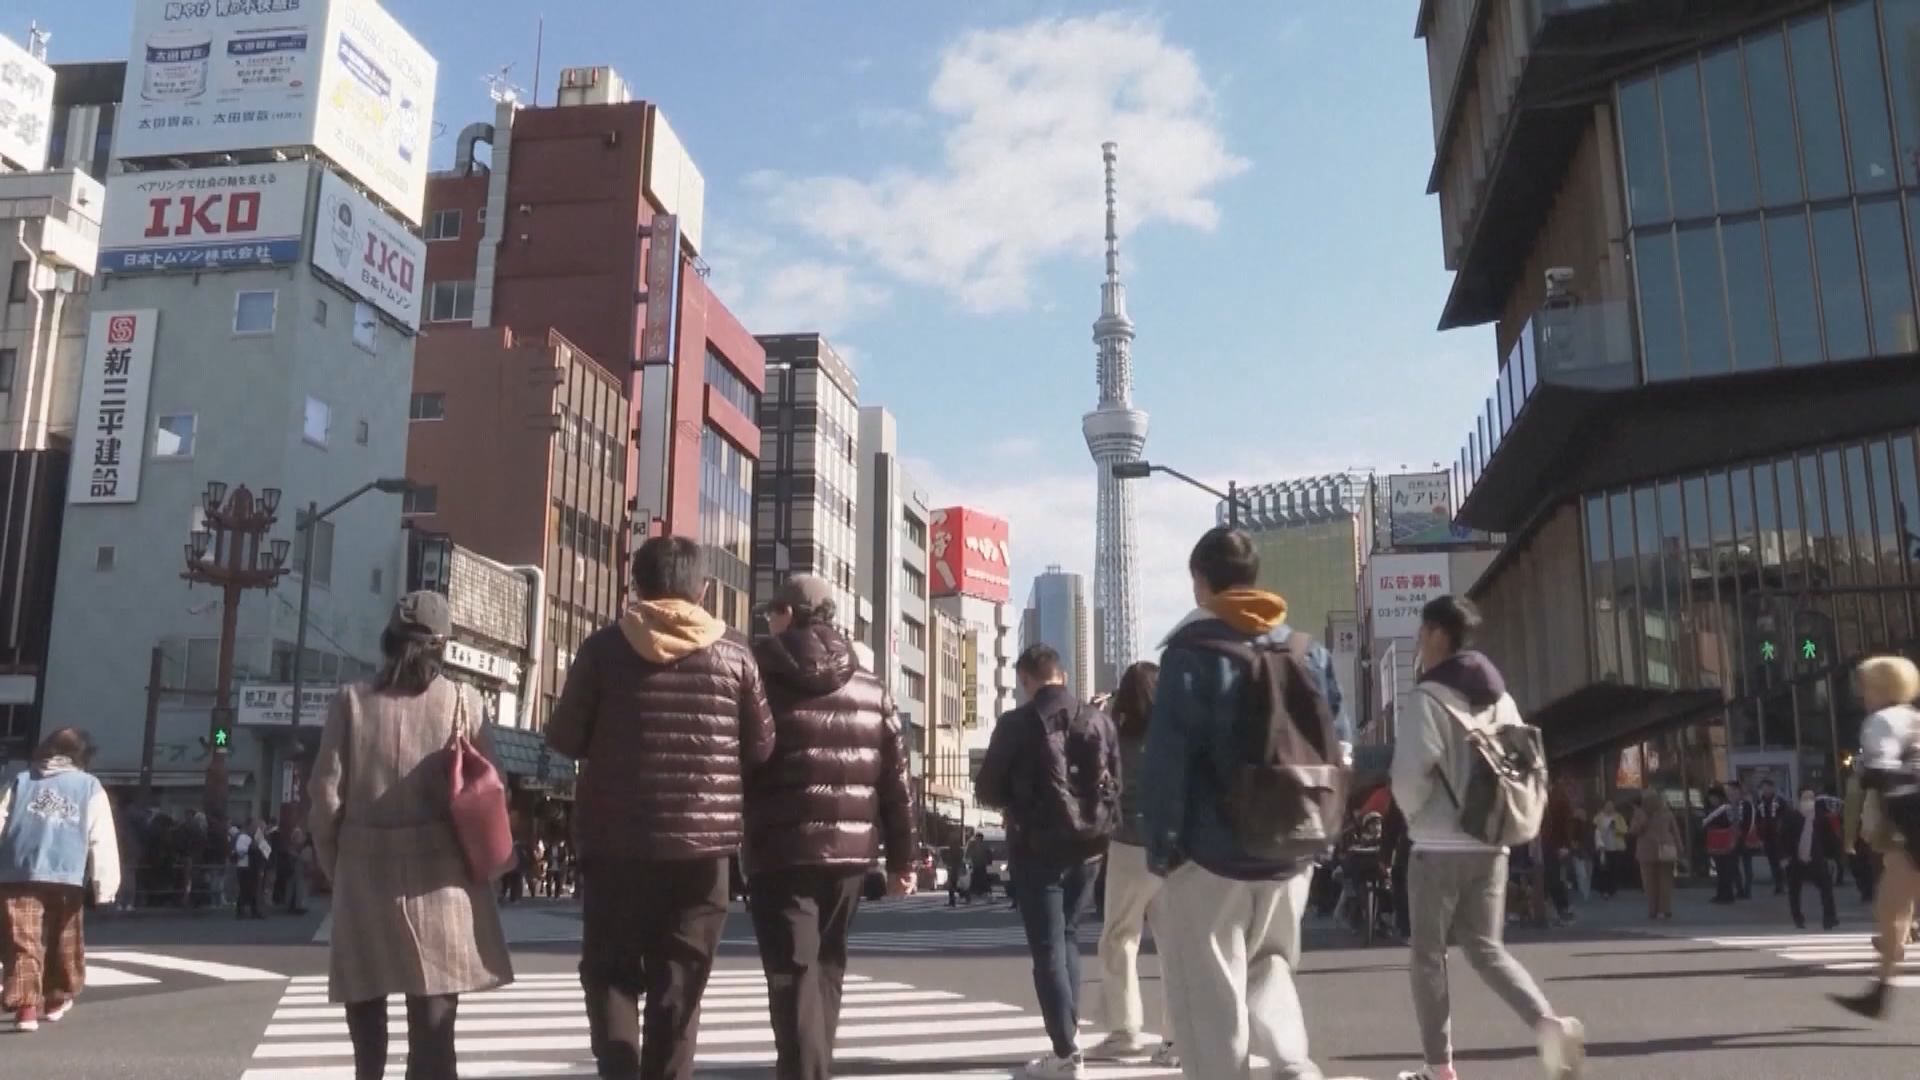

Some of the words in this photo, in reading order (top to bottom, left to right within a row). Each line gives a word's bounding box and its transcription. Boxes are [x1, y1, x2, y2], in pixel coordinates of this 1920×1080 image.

[144, 192, 261, 238] IKO
[123, 244, 272, 266] 日本トムソン株式会社
[364, 231, 414, 294] IKO
[90, 347, 132, 497] 新三平建設
[1380, 573, 1441, 590] 広告募集
